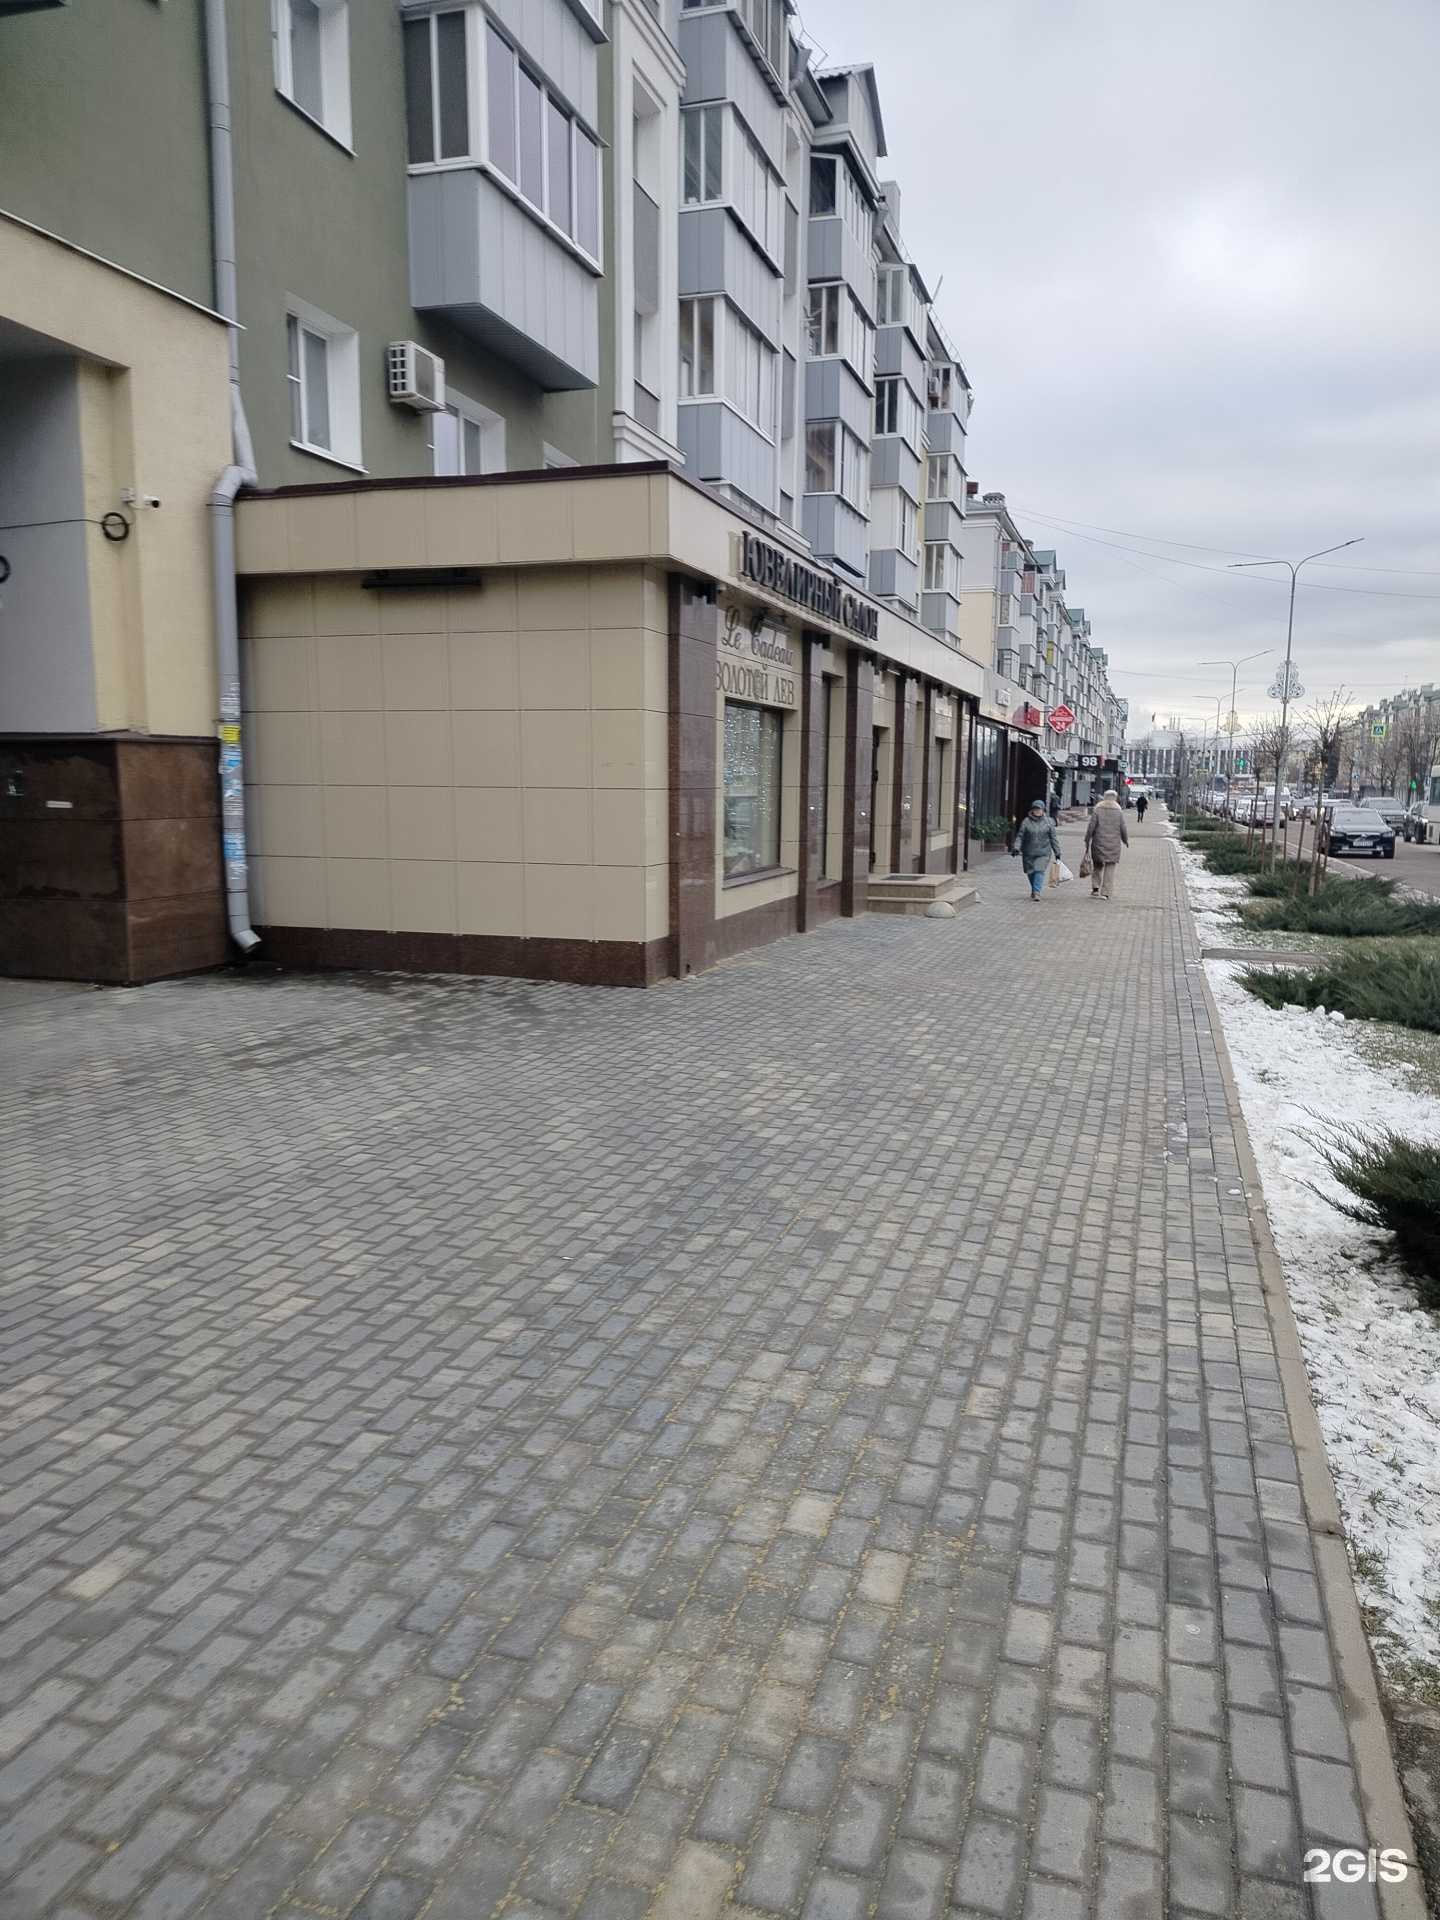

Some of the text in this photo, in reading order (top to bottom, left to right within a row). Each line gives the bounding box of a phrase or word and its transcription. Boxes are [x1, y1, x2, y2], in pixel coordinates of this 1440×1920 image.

[741, 531, 879, 641] ЮВЕЛИРНЫЙ САЛОН
[721, 605, 742, 650] Le
[773, 676, 794, 705] ЛЕВ
[1082, 756, 1098, 767] 98
